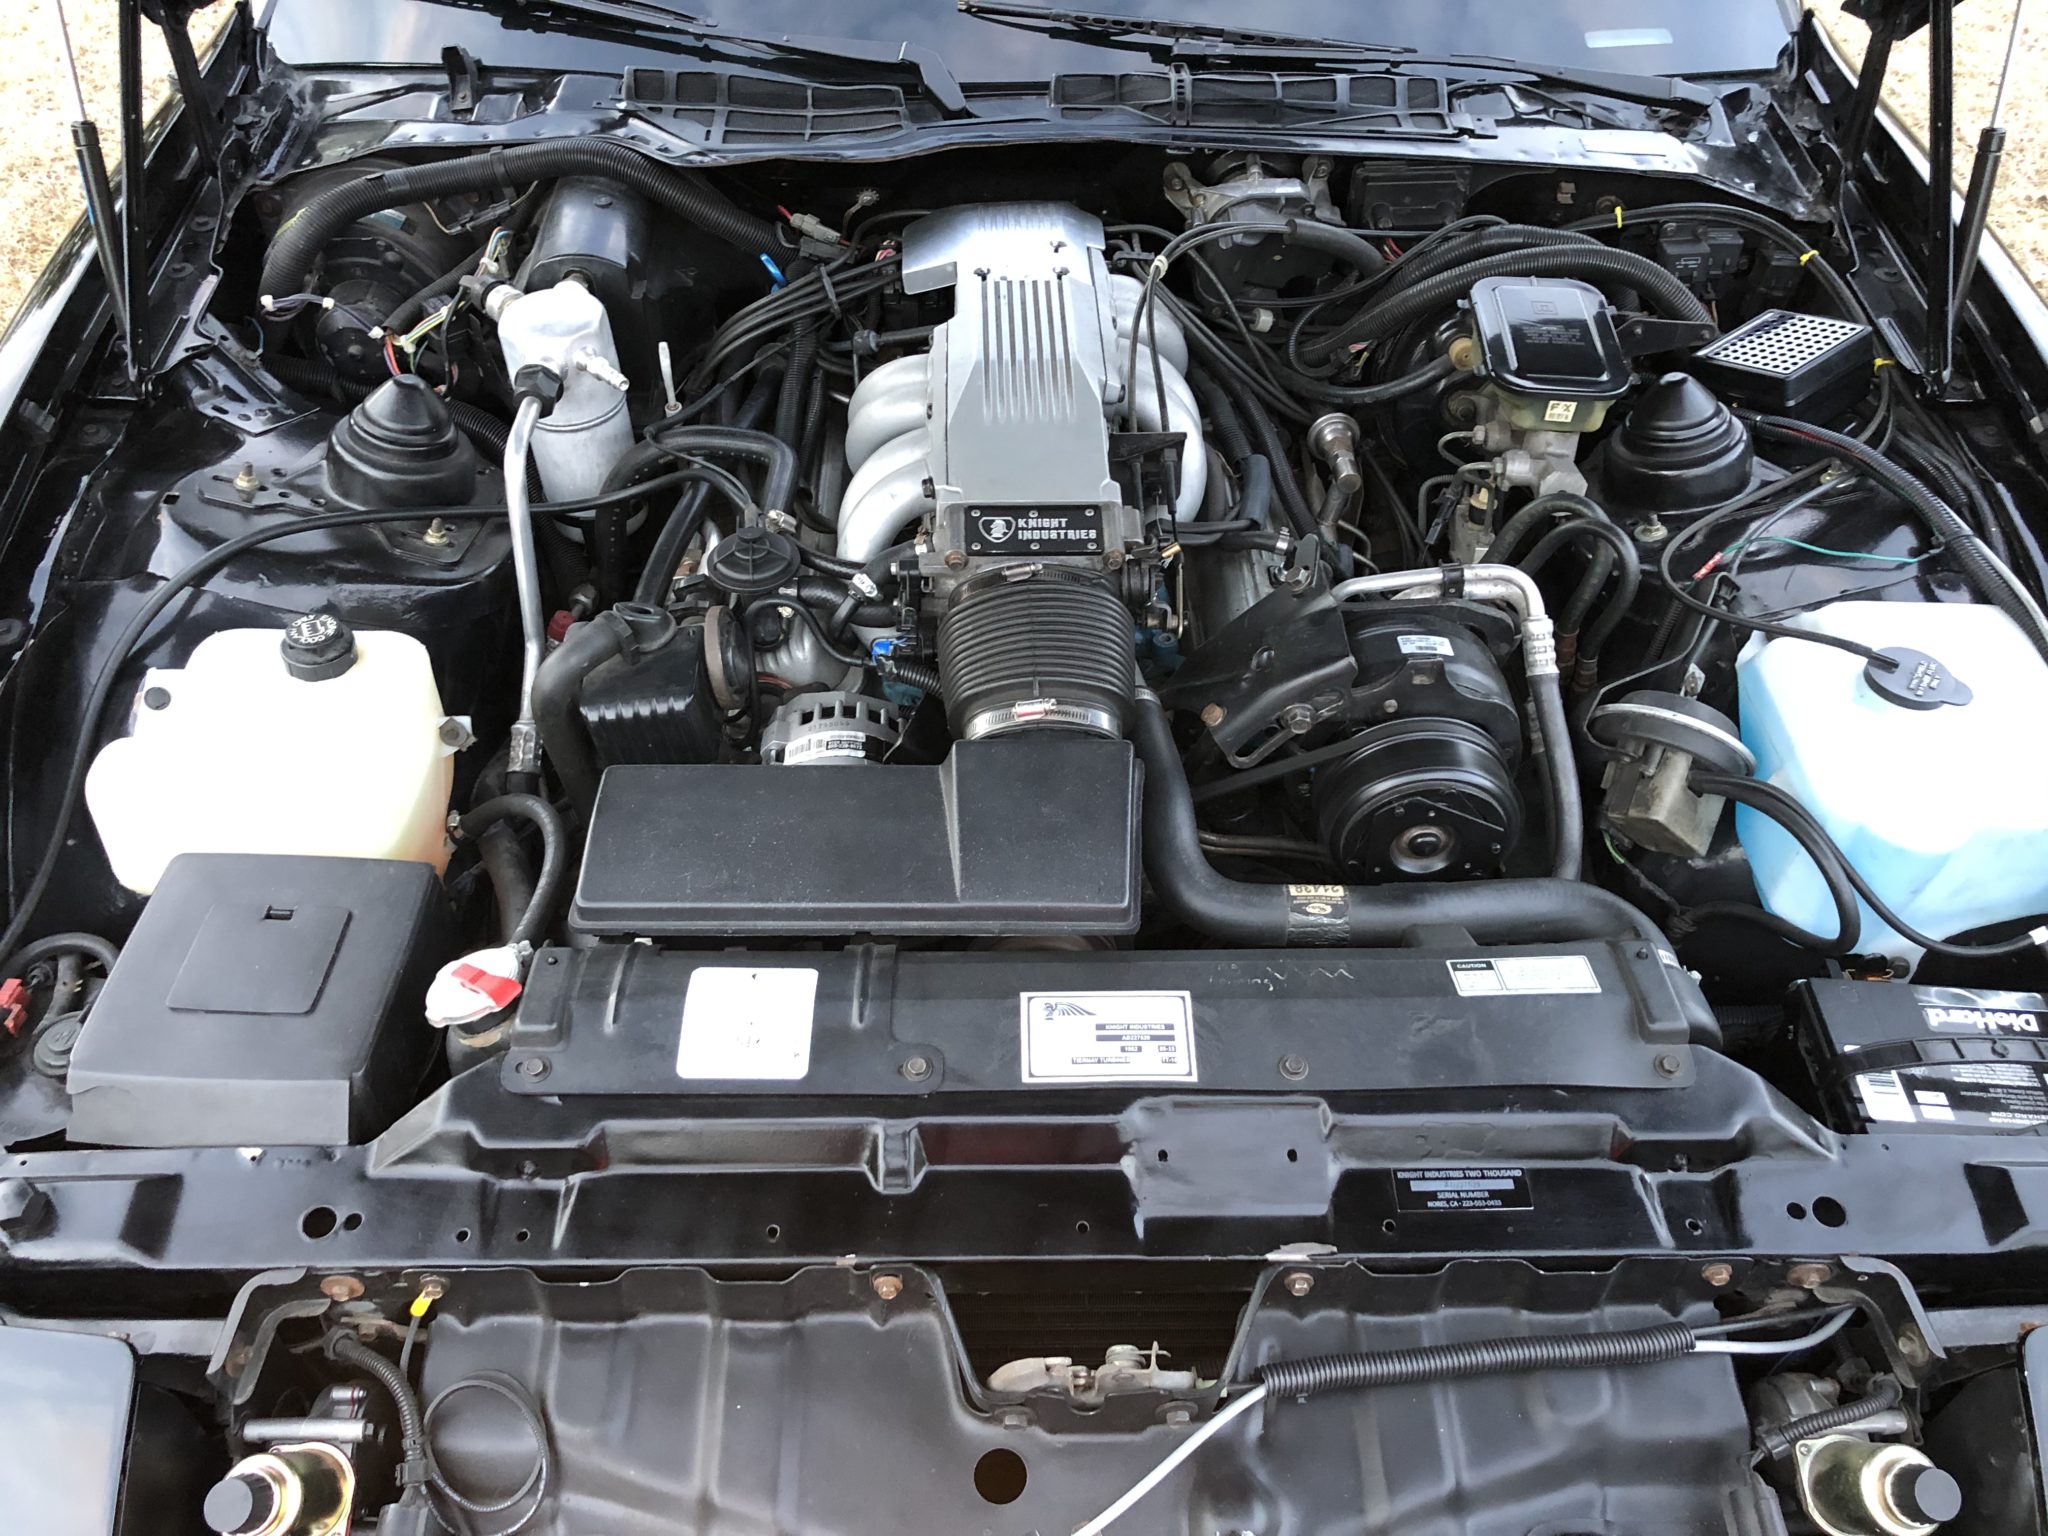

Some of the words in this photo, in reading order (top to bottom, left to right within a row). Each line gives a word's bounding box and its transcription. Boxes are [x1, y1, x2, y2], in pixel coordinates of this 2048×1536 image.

[1018, 518, 1068, 528] KNIGHT
[1018, 530, 1097, 540] INDUSTRIES
[1924, 1008, 2040, 1032] DieHard
[1483, 1169, 1522, 1177] THOUSAND
